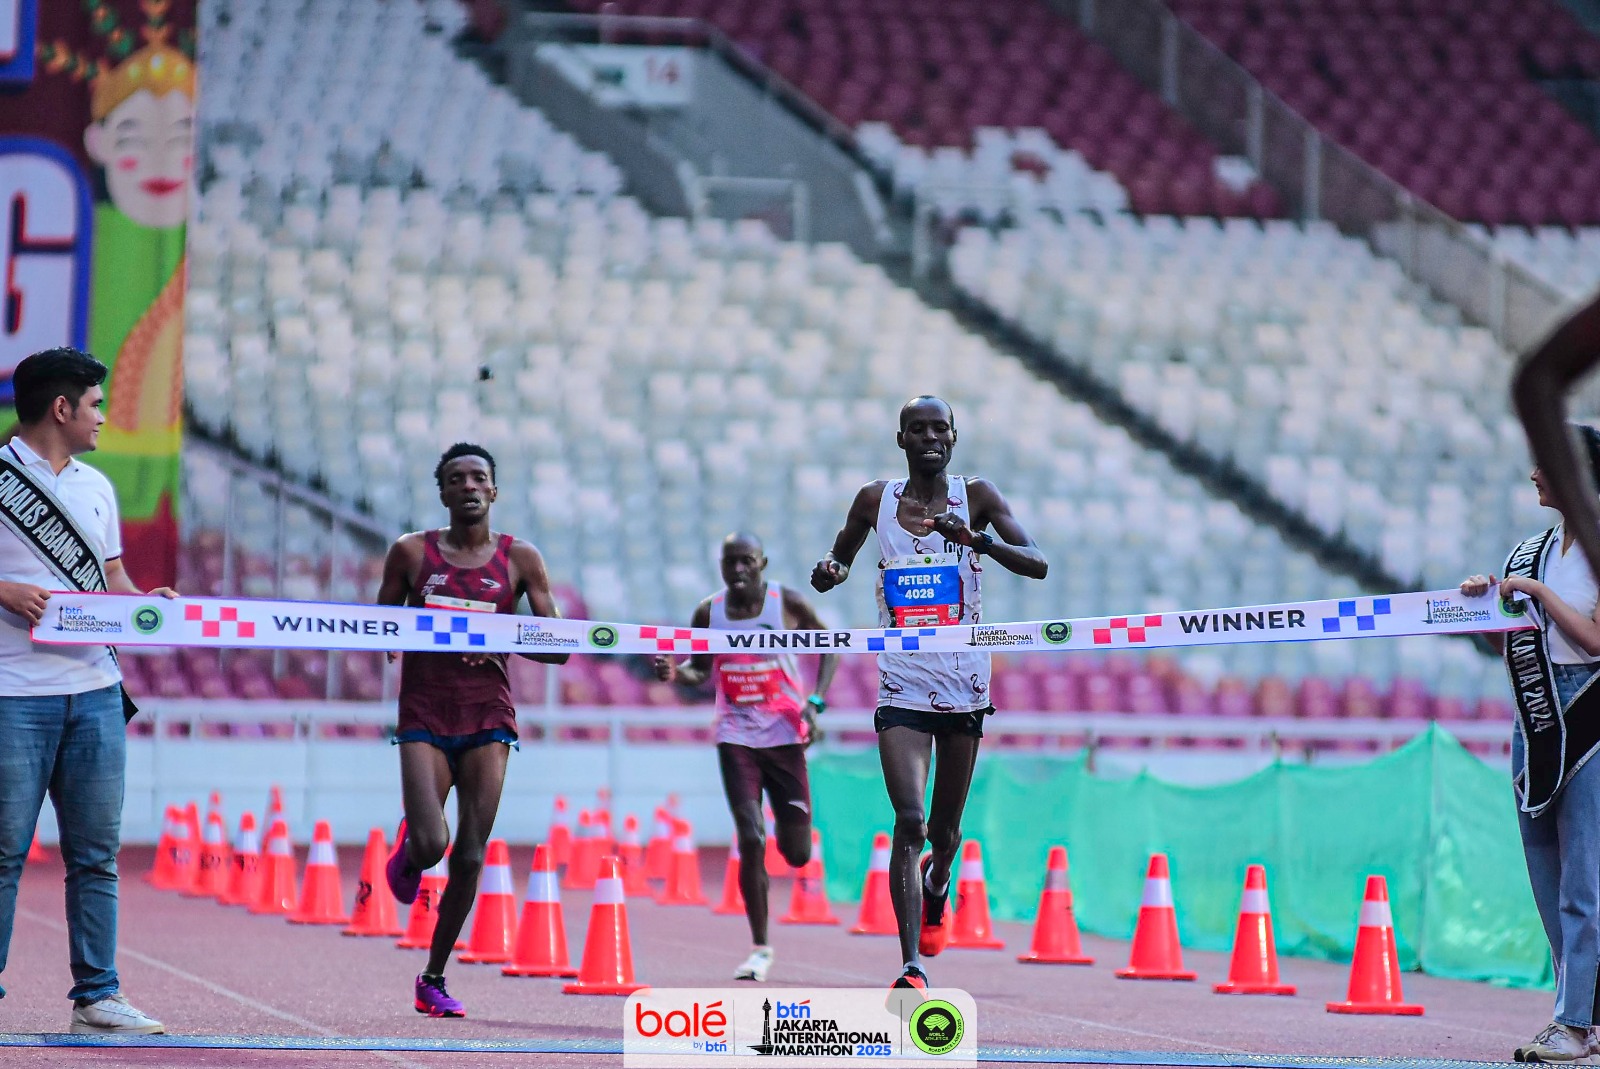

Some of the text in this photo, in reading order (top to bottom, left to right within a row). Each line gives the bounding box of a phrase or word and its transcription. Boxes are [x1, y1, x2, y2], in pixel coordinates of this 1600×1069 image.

[32, 515, 83, 572] ABANG
[897, 573, 942, 586] PETER K
[904, 588, 935, 600] 4028
[1432, 606, 1465, 614] JAKARTA
[1432, 610, 1491, 619] INTERNATIONAL
[63, 620, 123, 628] INTERNATIONAL
[272, 615, 400, 636] WINNER
[1178, 609, 1306, 634] WINNER
[726, 632, 852, 648] WINNER
[976, 634, 1034, 642] INTERNATIONAL
[1511, 630, 1556, 733] KARTA 2024
